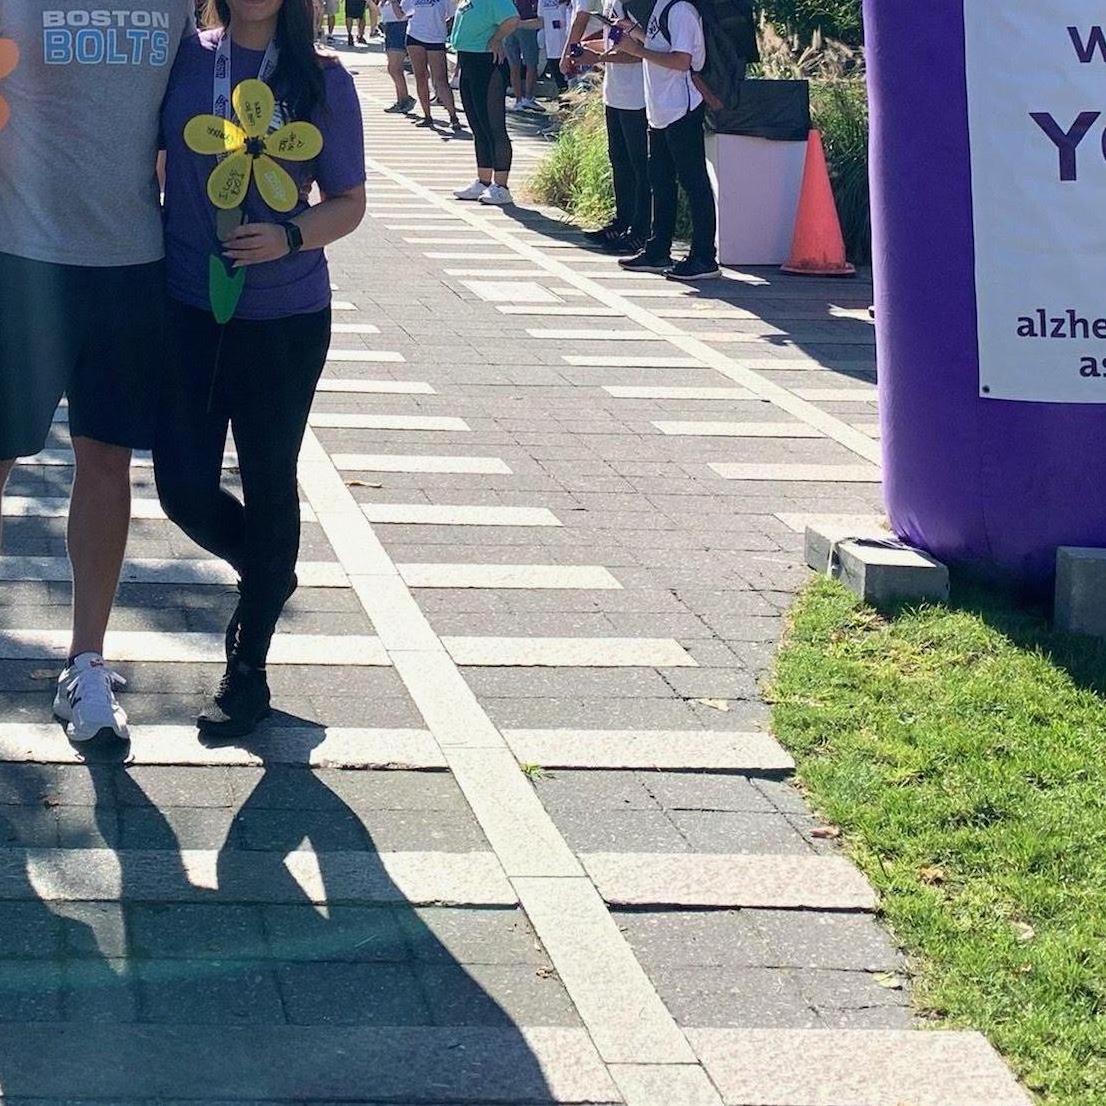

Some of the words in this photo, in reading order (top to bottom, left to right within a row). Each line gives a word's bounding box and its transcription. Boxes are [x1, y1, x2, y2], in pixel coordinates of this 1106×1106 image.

[43, 10, 170, 28] BOSTON
[44, 29, 170, 66] BOLTS
[1029, 112, 1106, 182] Y
